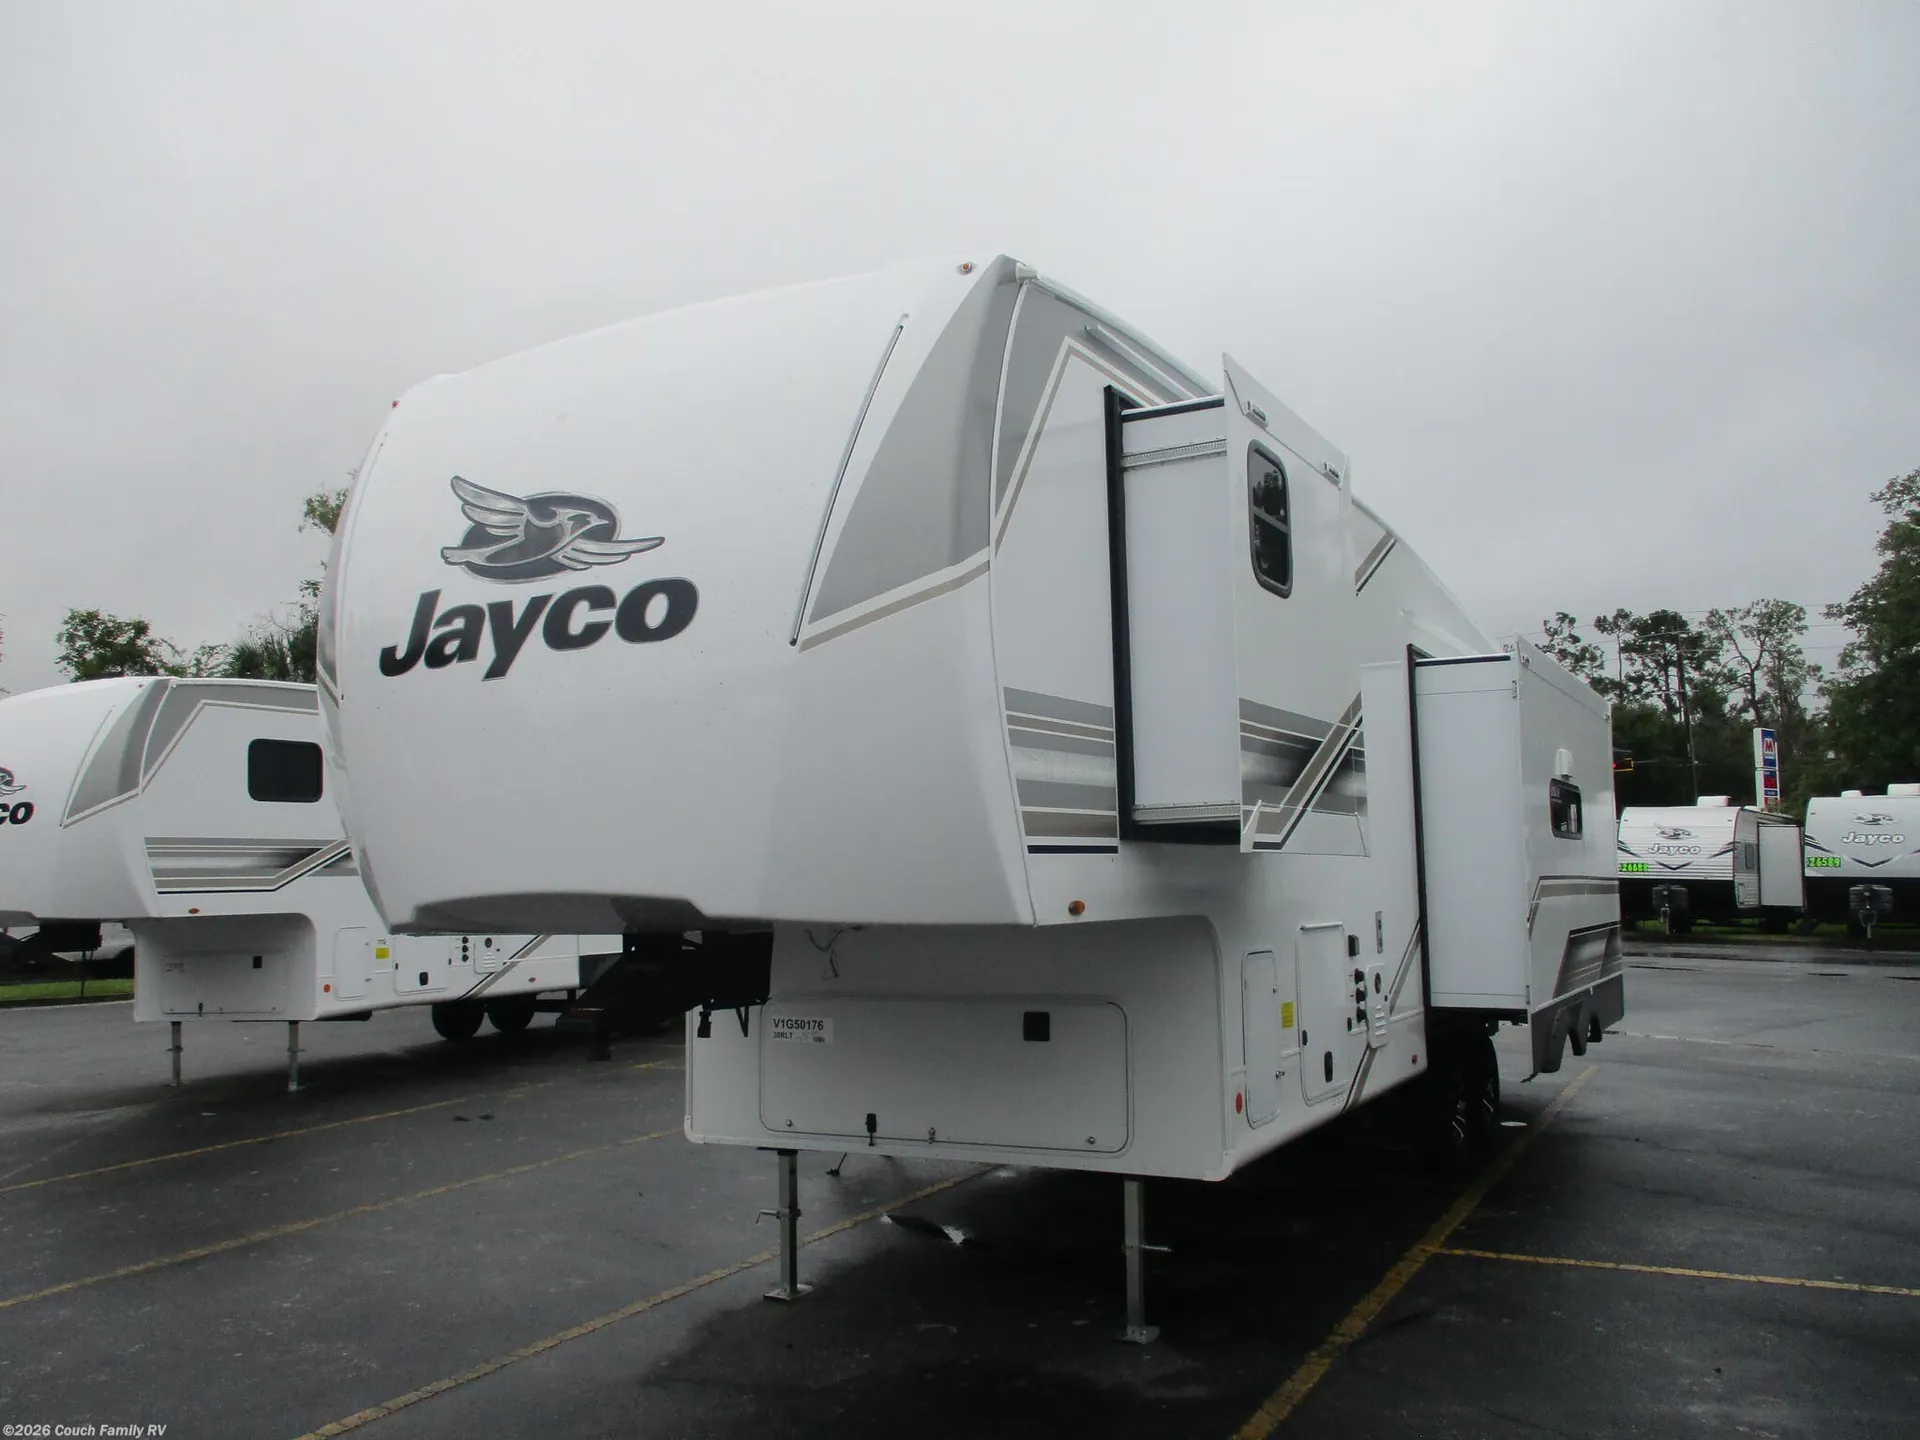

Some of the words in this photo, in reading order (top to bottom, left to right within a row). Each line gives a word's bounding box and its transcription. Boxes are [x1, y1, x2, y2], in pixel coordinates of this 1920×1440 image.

[379, 576, 700, 681] Jayco
[1841, 832, 1906, 845] Jayco
[1647, 843, 1701, 856] Jayco
[773, 1018, 824, 1031] V1G50176
